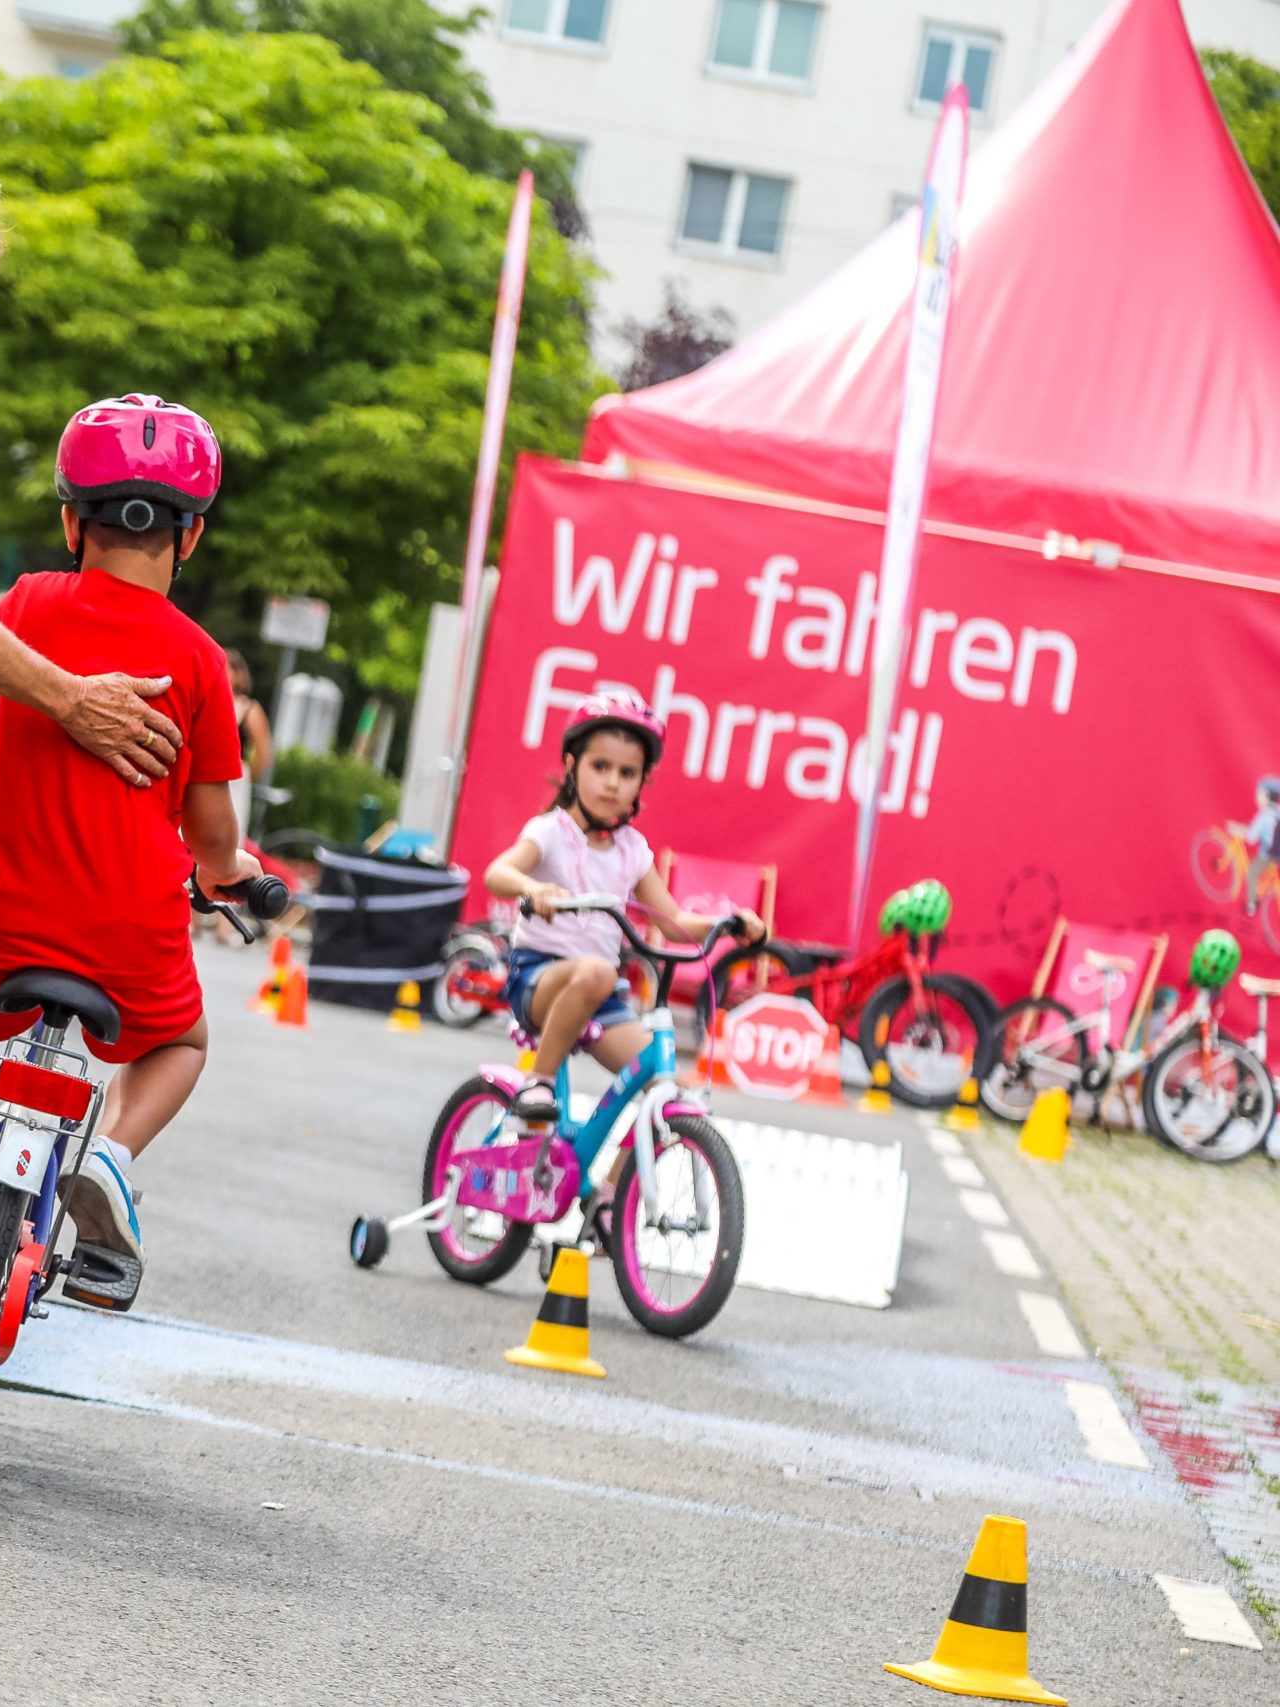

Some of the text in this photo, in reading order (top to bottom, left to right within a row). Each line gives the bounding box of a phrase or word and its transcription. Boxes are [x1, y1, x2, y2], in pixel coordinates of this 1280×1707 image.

[552, 517, 718, 646] Wir
[522, 646, 944, 819] Fhrrad!
[732, 1020, 825, 1073] STOP
